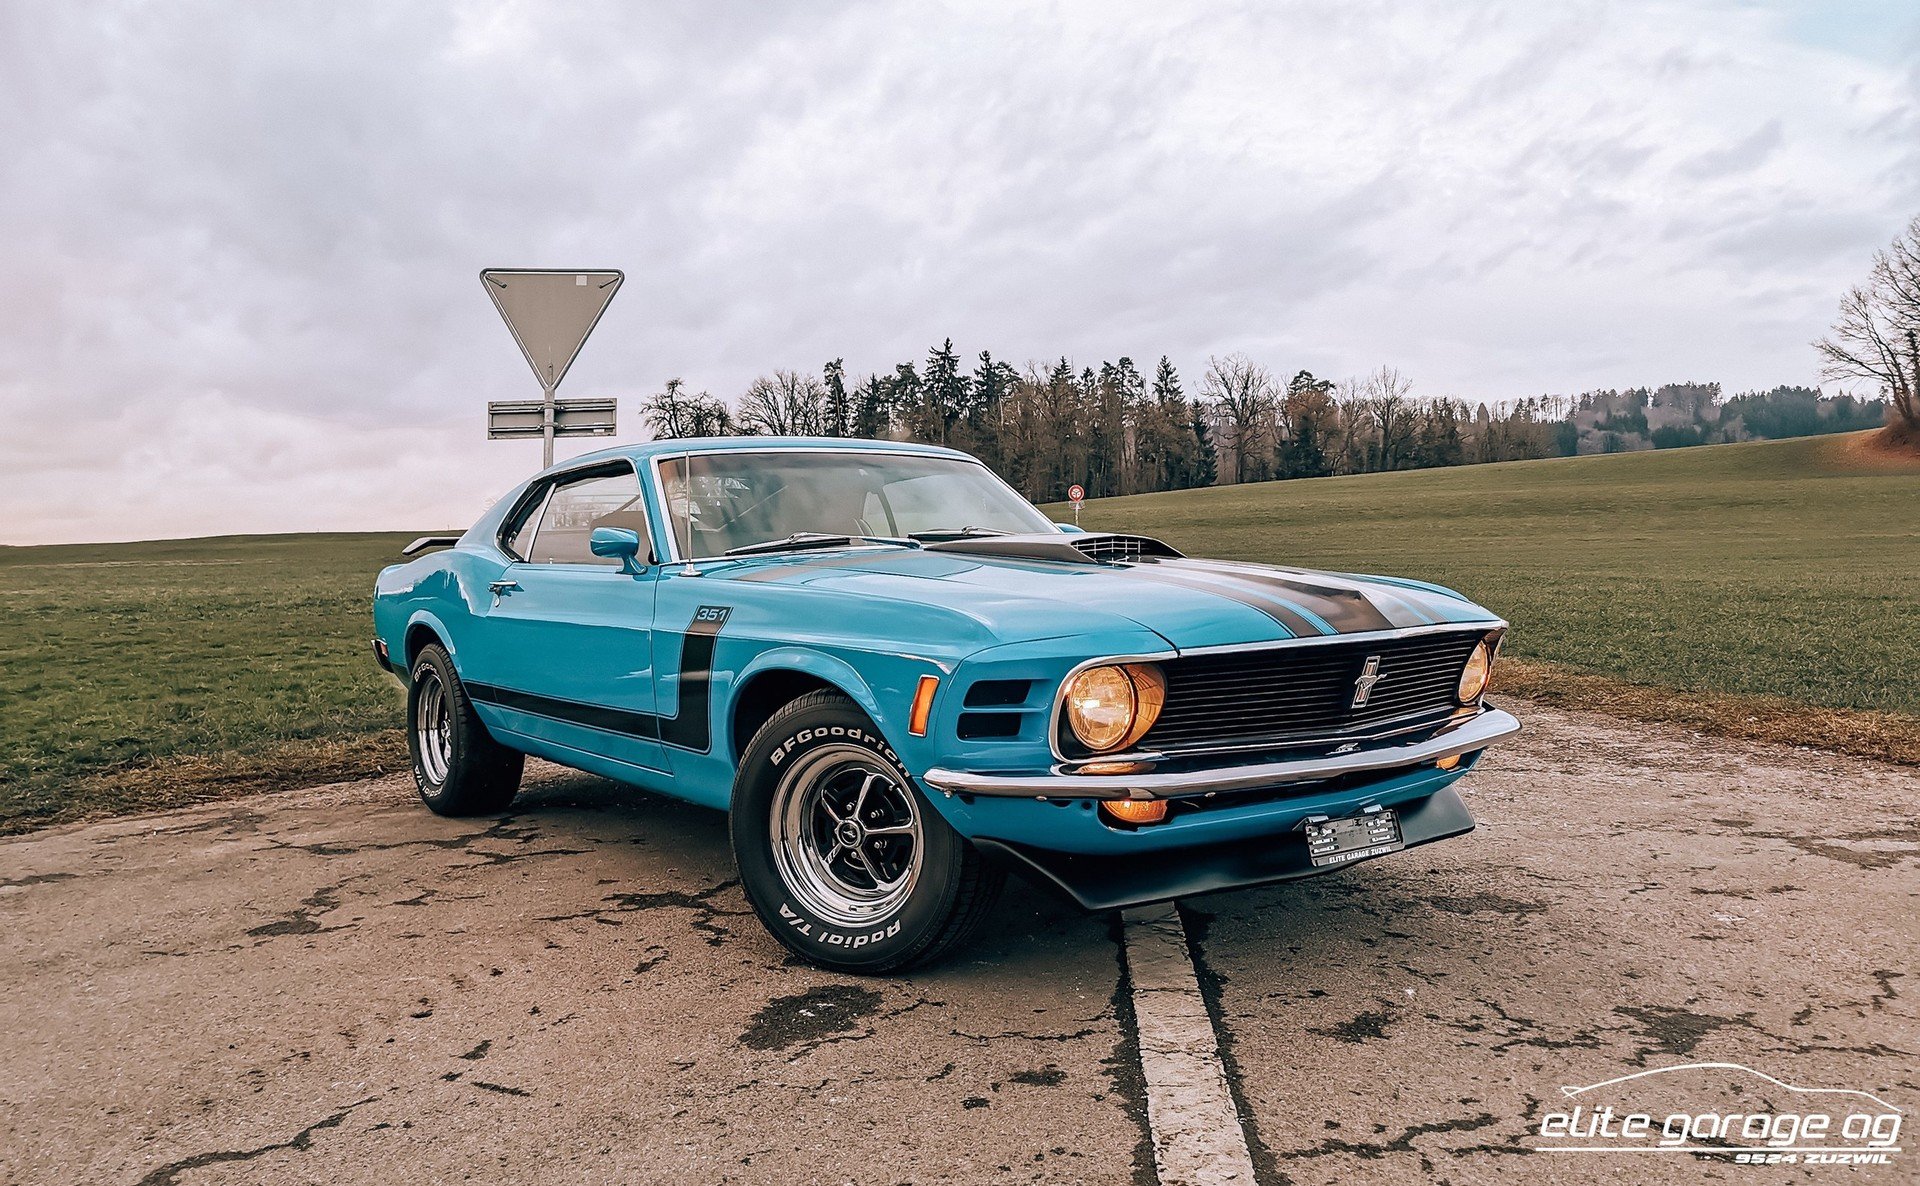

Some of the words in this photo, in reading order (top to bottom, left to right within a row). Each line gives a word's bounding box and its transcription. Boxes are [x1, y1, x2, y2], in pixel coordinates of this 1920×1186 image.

[697, 608, 727, 621] 351
[1329, 854, 1346, 864] ELITE
[1346, 850, 1369, 861] GARAGE
[1371, 845, 1392, 856] ZUZWIL
[778, 902, 812, 936] T/A
[818, 919, 901, 949] Radial
